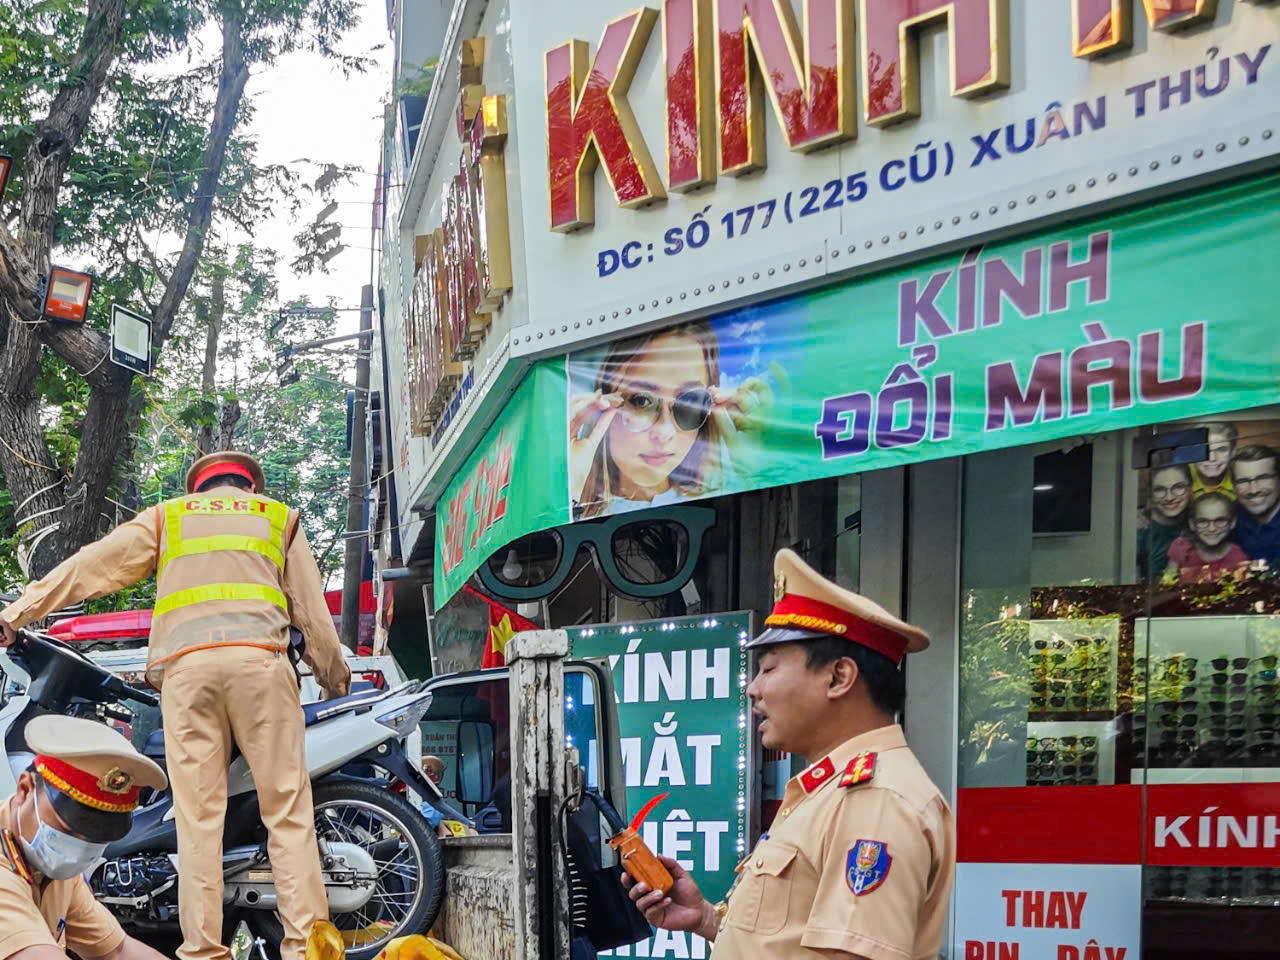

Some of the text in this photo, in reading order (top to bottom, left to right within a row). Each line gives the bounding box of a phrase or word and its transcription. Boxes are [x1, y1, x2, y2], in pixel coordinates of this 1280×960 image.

[597, 240, 656, 278] ĐC:
[663, 204, 713, 256] SỐ
[879, 140, 955, 192] CŨ)
[970, 95, 1107, 168] XUÂN
[1125, 44, 1272, 119] THỦY
[898, 229, 1112, 348] KÍNH
[815, 320, 1208, 460] ĐỔI MÀU
[1001, 889, 1089, 930] THAY
